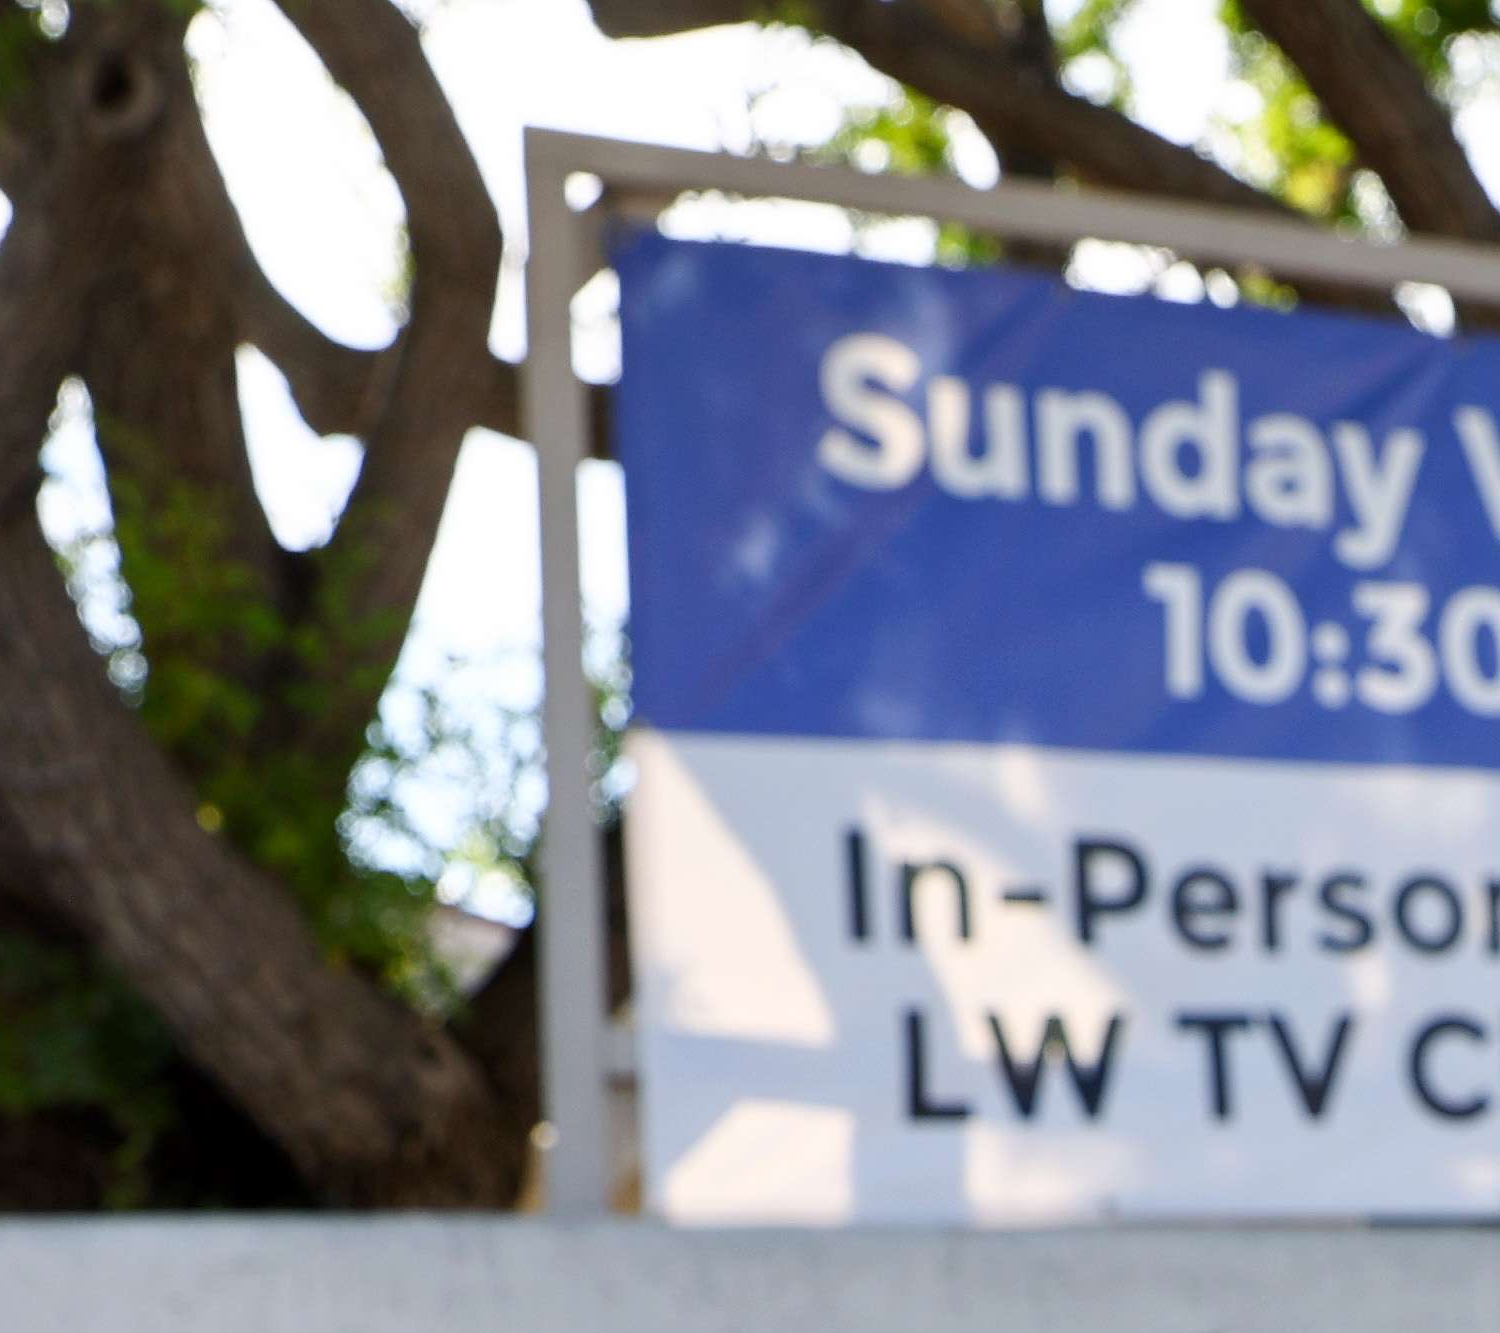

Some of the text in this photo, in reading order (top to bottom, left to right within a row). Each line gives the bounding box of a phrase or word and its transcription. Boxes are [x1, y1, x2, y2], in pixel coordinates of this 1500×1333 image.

[818, 331, 1425, 570] Sunday
[903, 1008, 1122, 1122] LW
[1176, 1009, 1353, 1121] TV
